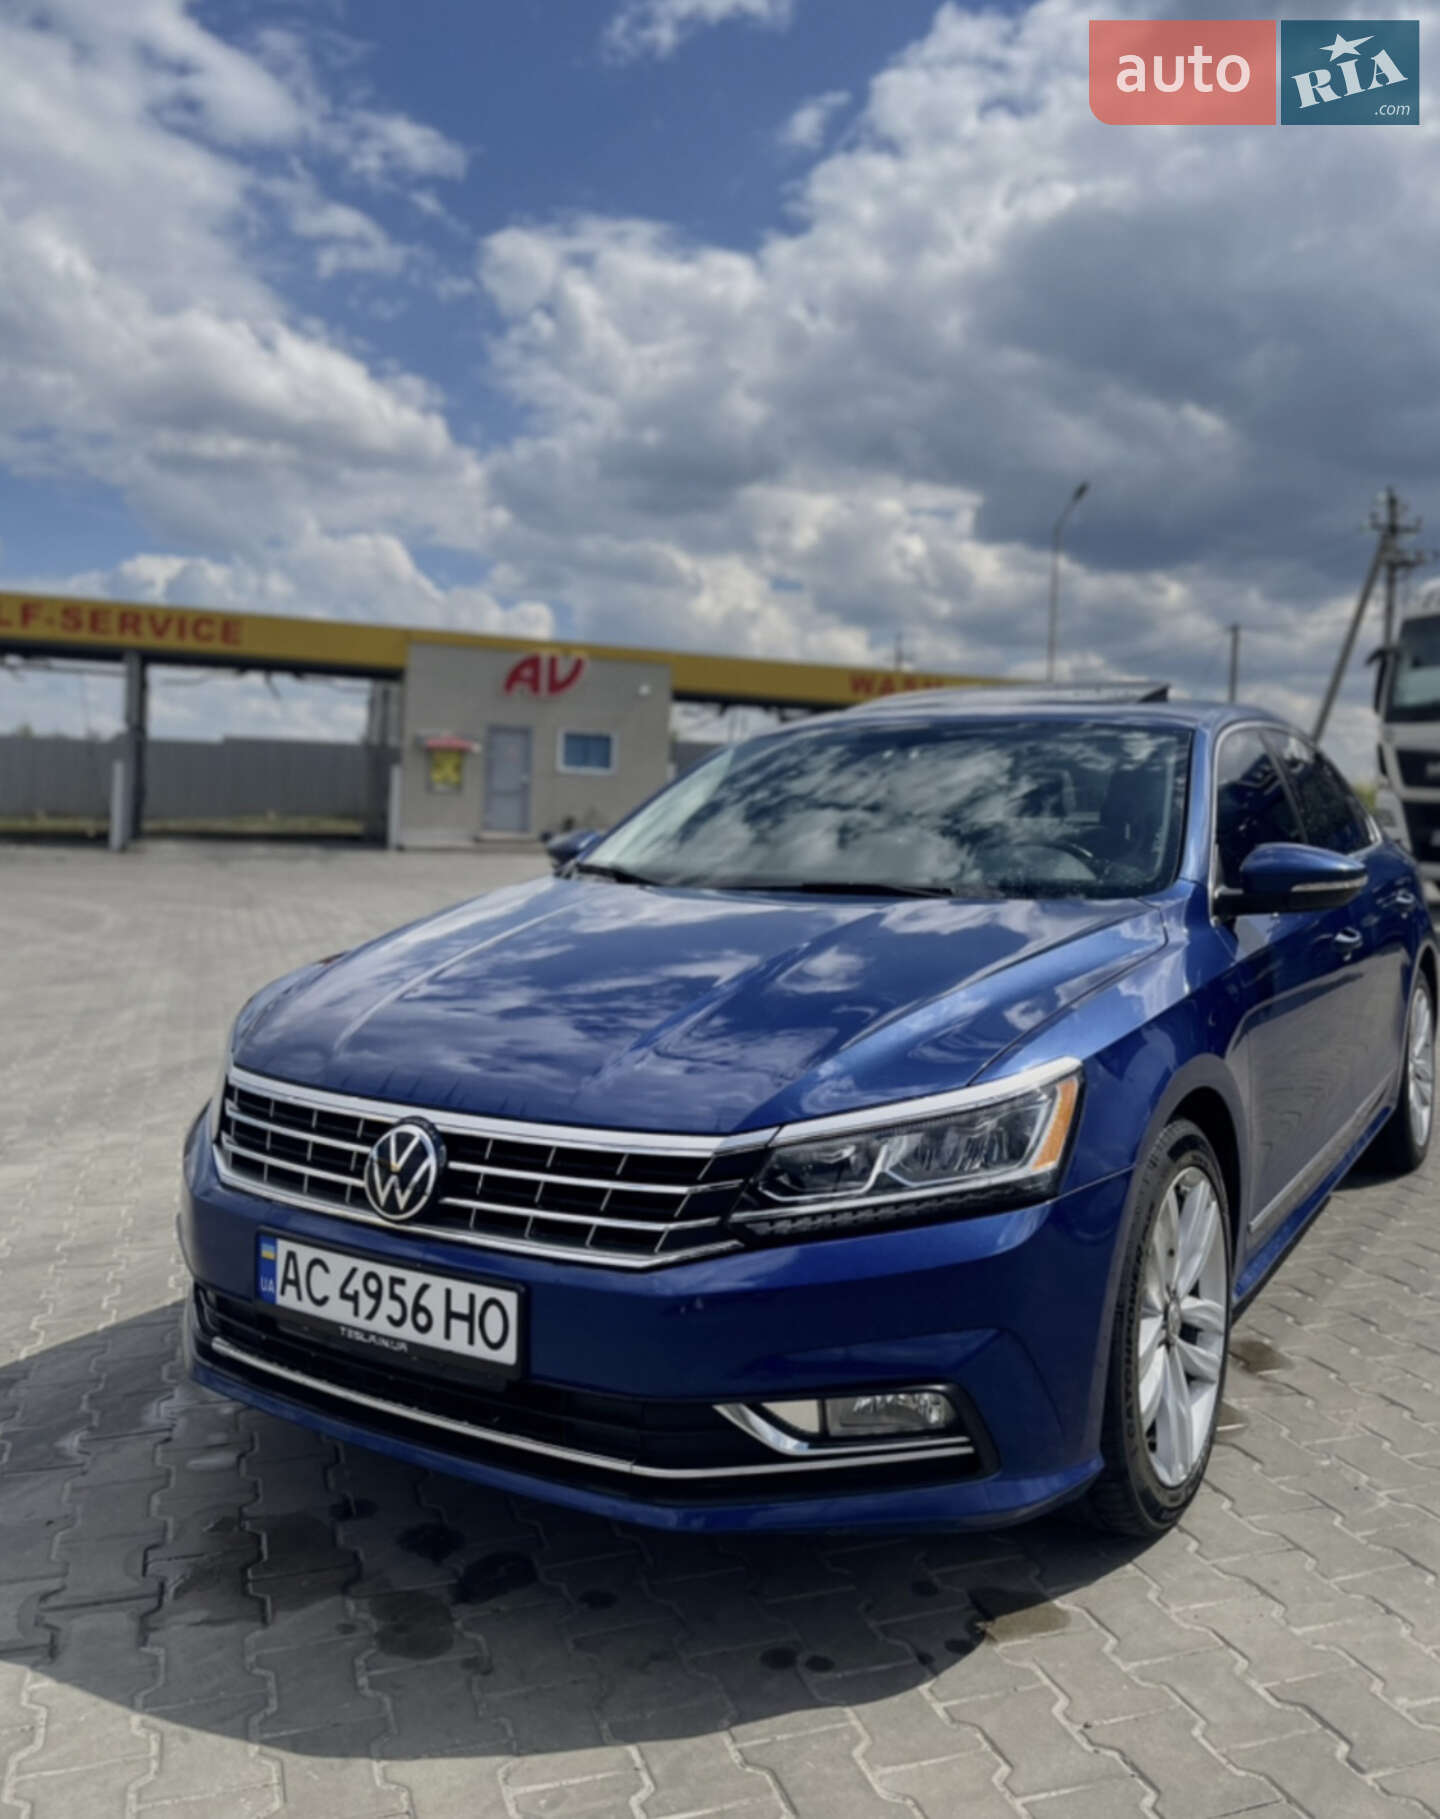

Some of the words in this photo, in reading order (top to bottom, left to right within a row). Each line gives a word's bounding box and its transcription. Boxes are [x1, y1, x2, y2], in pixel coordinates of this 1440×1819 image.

[503, 652, 586, 696] AV
[260, 1276, 275, 1294] UA
[339, 1267, 433, 1334] 4956
